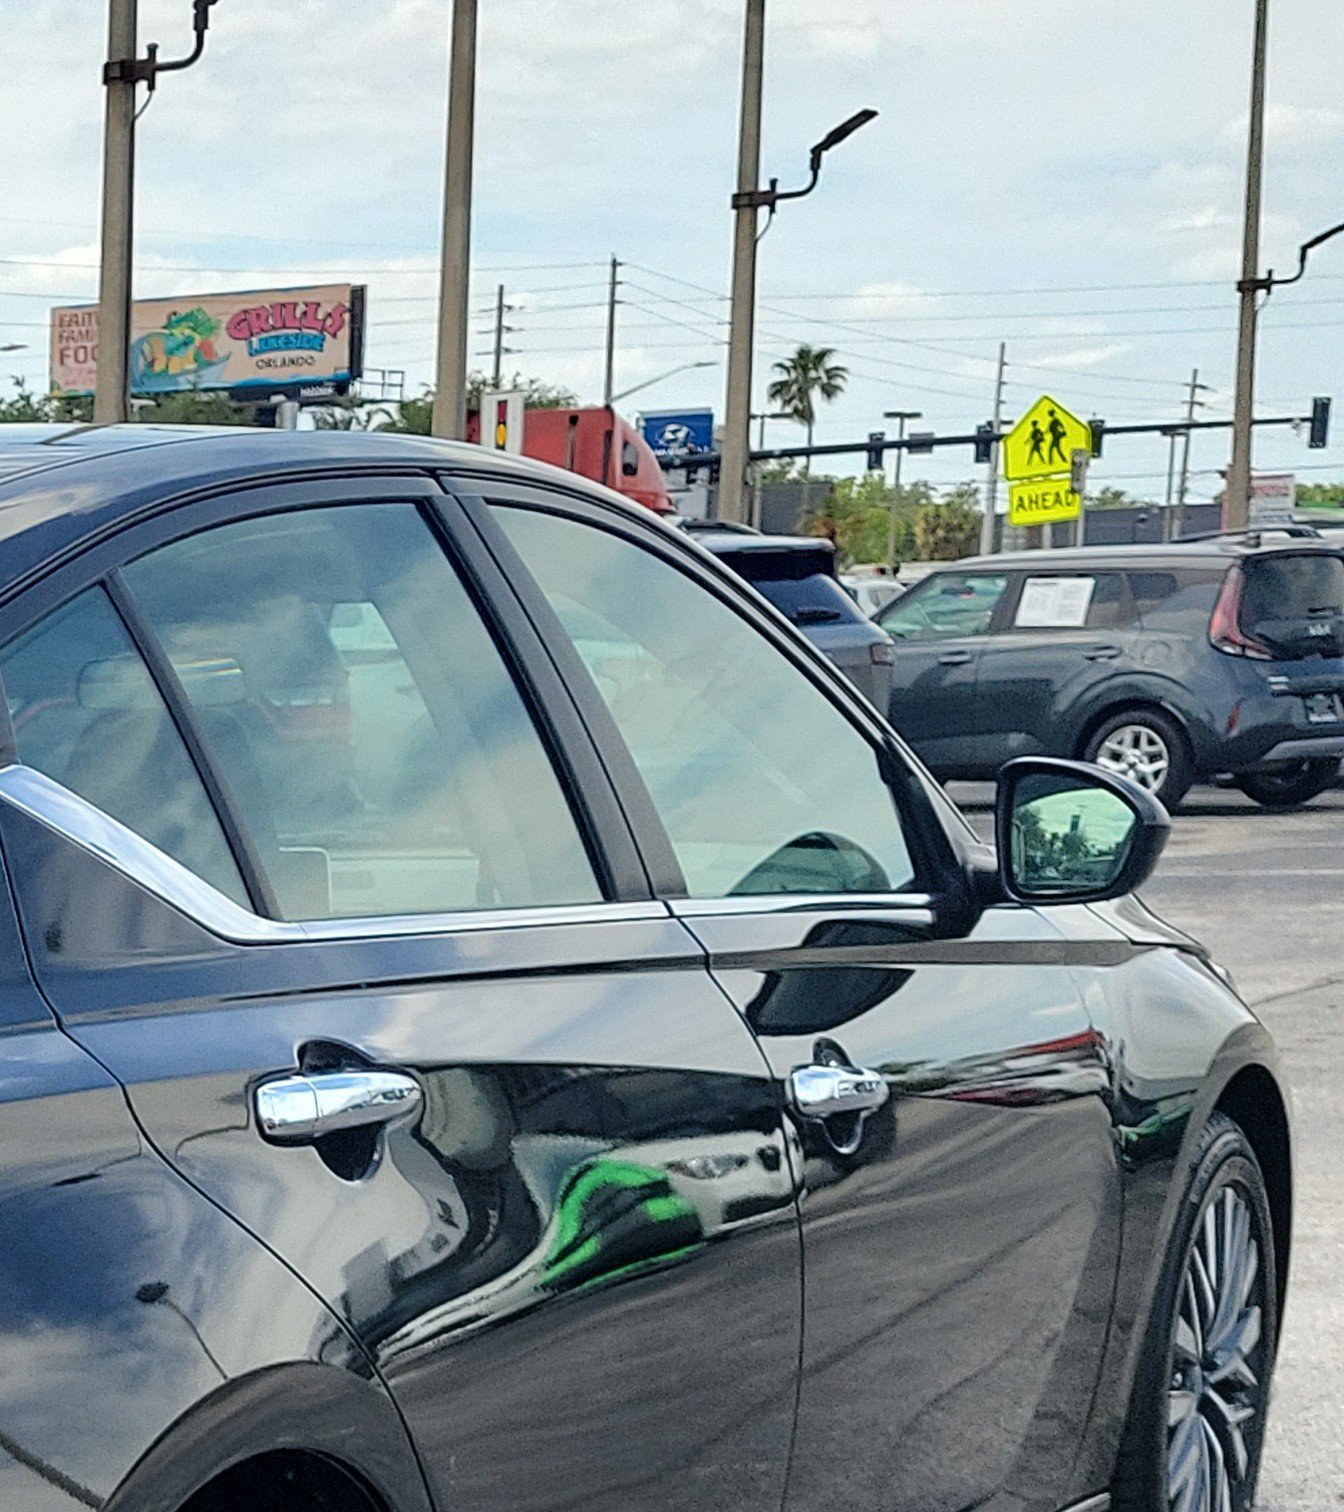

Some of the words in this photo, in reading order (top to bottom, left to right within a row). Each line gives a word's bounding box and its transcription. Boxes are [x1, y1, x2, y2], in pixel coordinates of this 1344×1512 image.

[225, 302, 349, 341] GRILLS
[255, 356, 316, 370] ORLANDO
[1015, 488, 1077, 513] AHEAD
